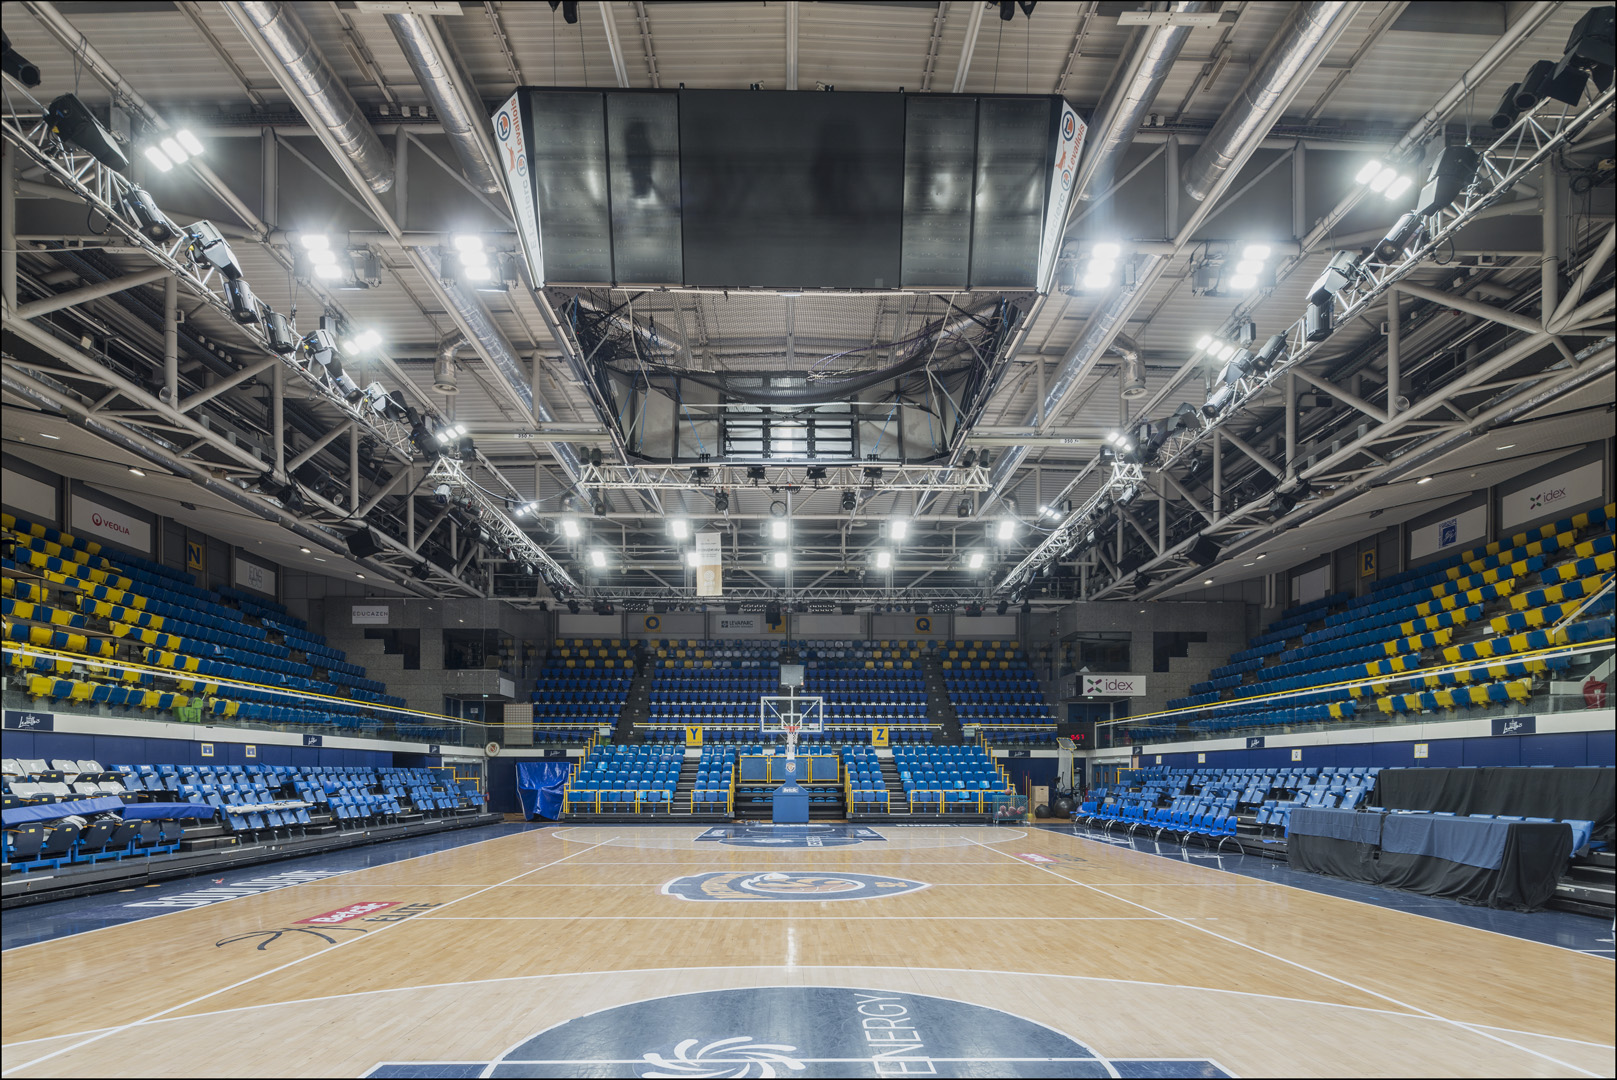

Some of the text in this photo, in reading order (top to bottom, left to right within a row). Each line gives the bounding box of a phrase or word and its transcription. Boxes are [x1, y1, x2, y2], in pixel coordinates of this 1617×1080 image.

[510, 98, 523, 154] Levallois
[1068, 123, 1085, 172] Levallois
[1543, 487, 1567, 503] idex
[103, 519, 130, 536] VEOLIA
[188, 544, 201, 565] N
[1364, 553, 1374, 571] R
[916, 617, 931, 632] Q
[1105, 678, 1134, 691] idex
[690, 728, 699, 740] Y
[876, 728, 885, 741] Z
[123, 869, 353, 908] BOULOGNE
[310, 902, 390, 923] Betclic
[853, 993, 938, 1075] ENERGY
